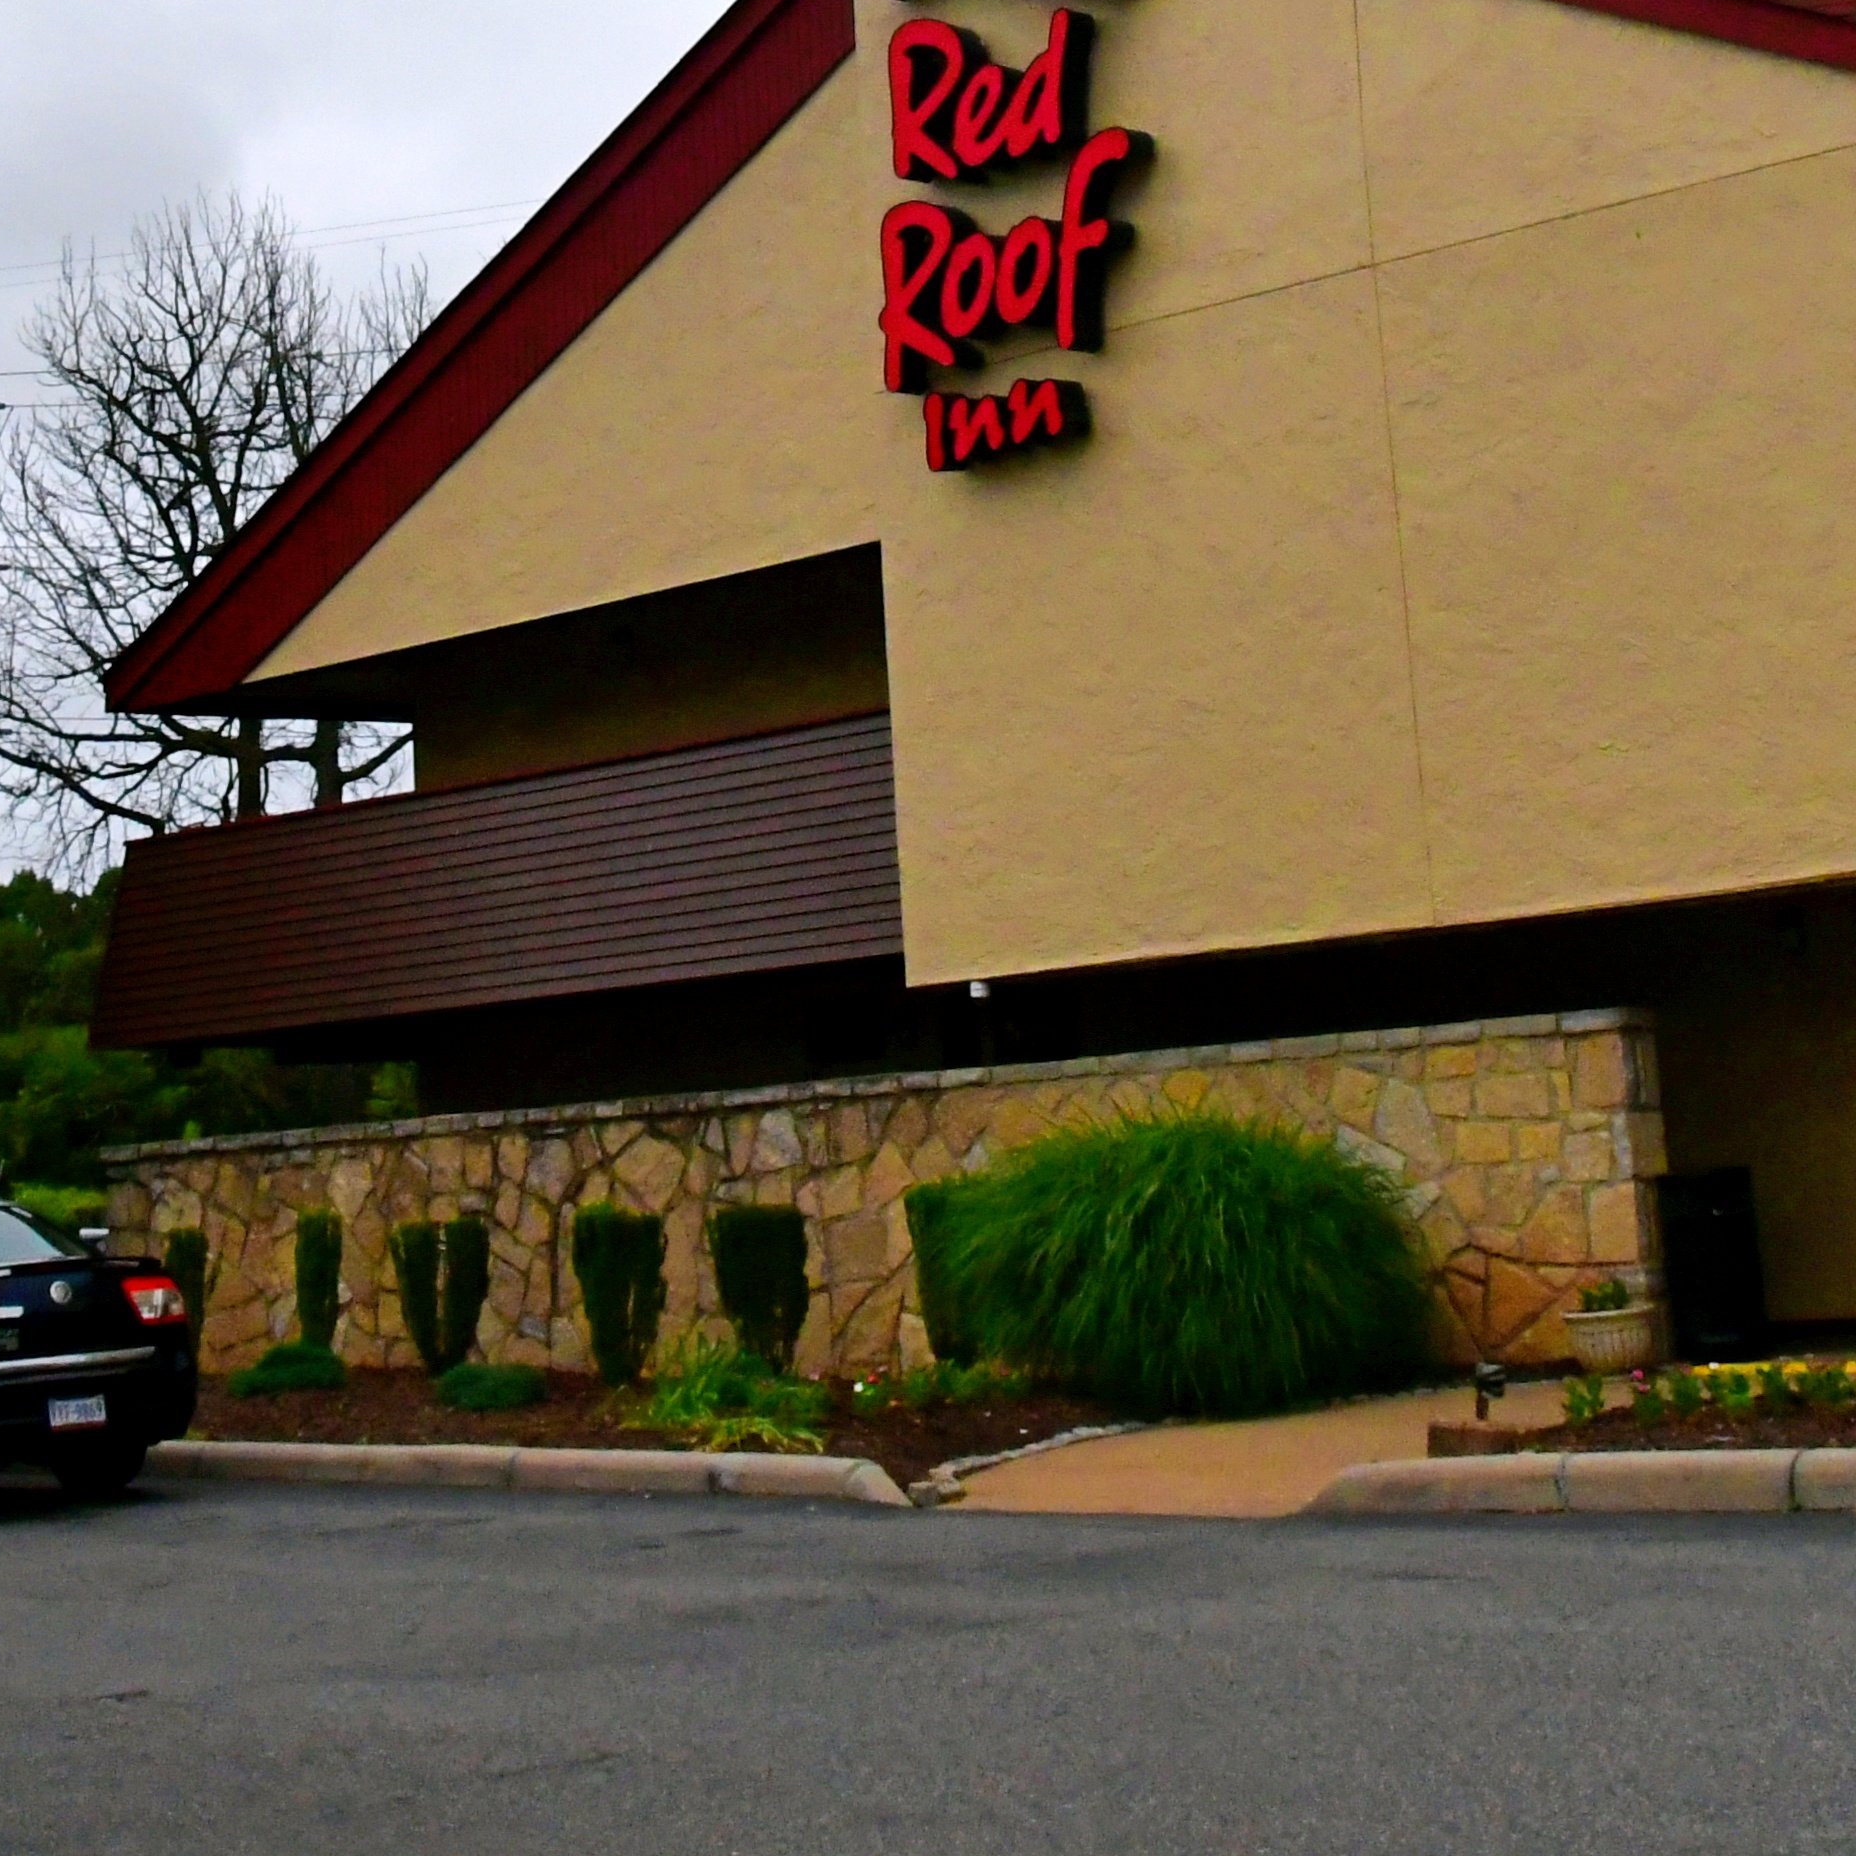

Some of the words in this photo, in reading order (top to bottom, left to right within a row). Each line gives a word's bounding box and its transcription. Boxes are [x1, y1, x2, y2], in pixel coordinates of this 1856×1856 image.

[889, 7, 1069, 179] Red
[880, 127, 1130, 392] Roof
[924, 379, 1064, 472] Inn
